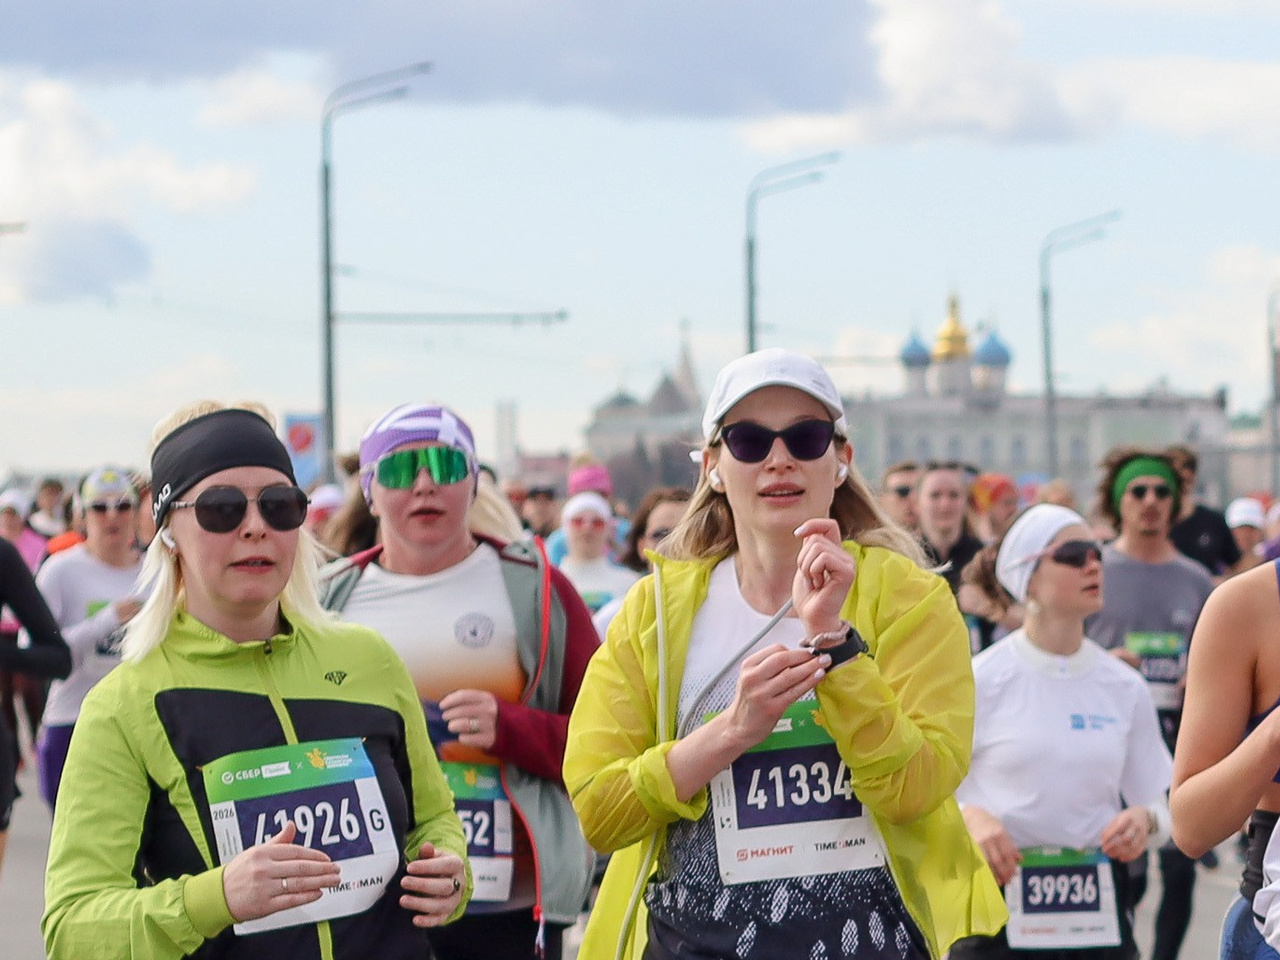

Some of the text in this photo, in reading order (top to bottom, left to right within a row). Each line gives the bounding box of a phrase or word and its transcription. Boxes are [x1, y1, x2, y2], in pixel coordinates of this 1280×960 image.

[746, 760, 854, 810] 41334
[213, 807, 235, 821] 2026
[369, 809, 385, 832] G
[457, 809, 490, 846] 52
[750, 845, 794, 858] МАГНИТ
[1027, 873, 1098, 906] 39936
